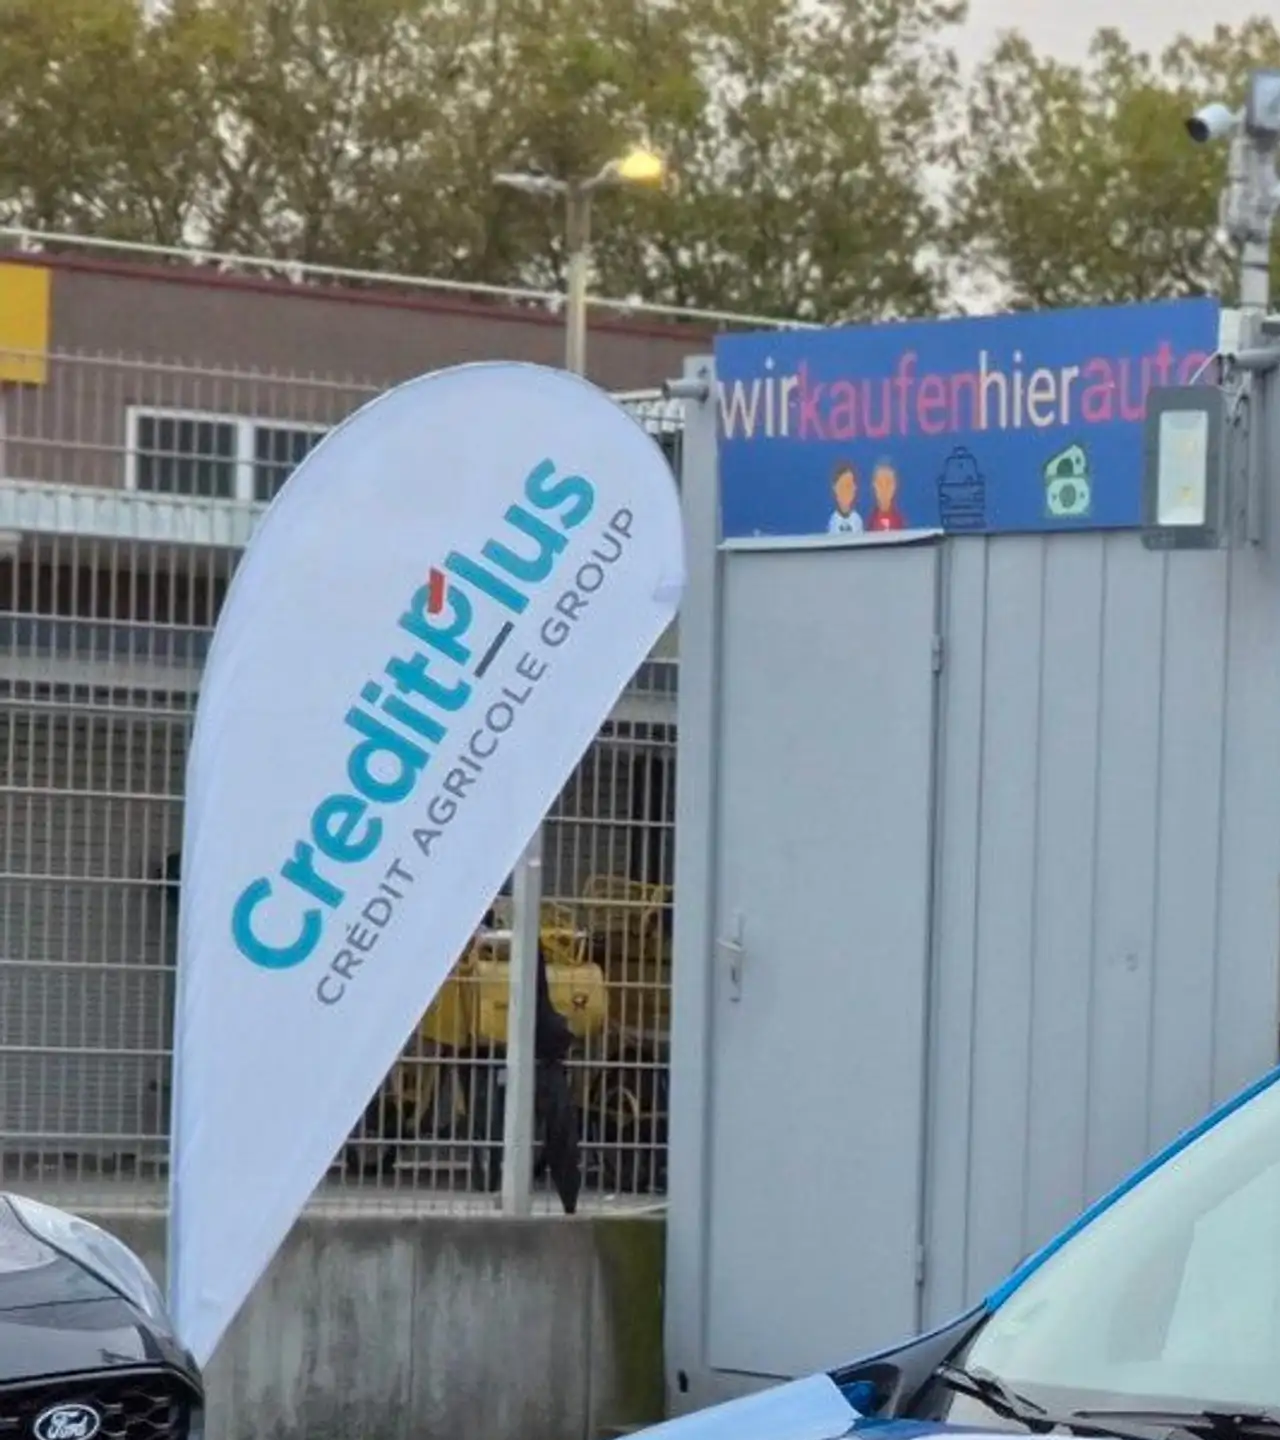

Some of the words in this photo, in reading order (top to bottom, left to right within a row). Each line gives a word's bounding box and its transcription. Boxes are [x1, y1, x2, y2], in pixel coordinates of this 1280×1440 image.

[231, 458, 596, 972] Creditplus
[318, 870, 413, 1006] CRÉDIT
[412, 651, 549, 854] AGRICOLE
[537, 508, 637, 648] GROUP
